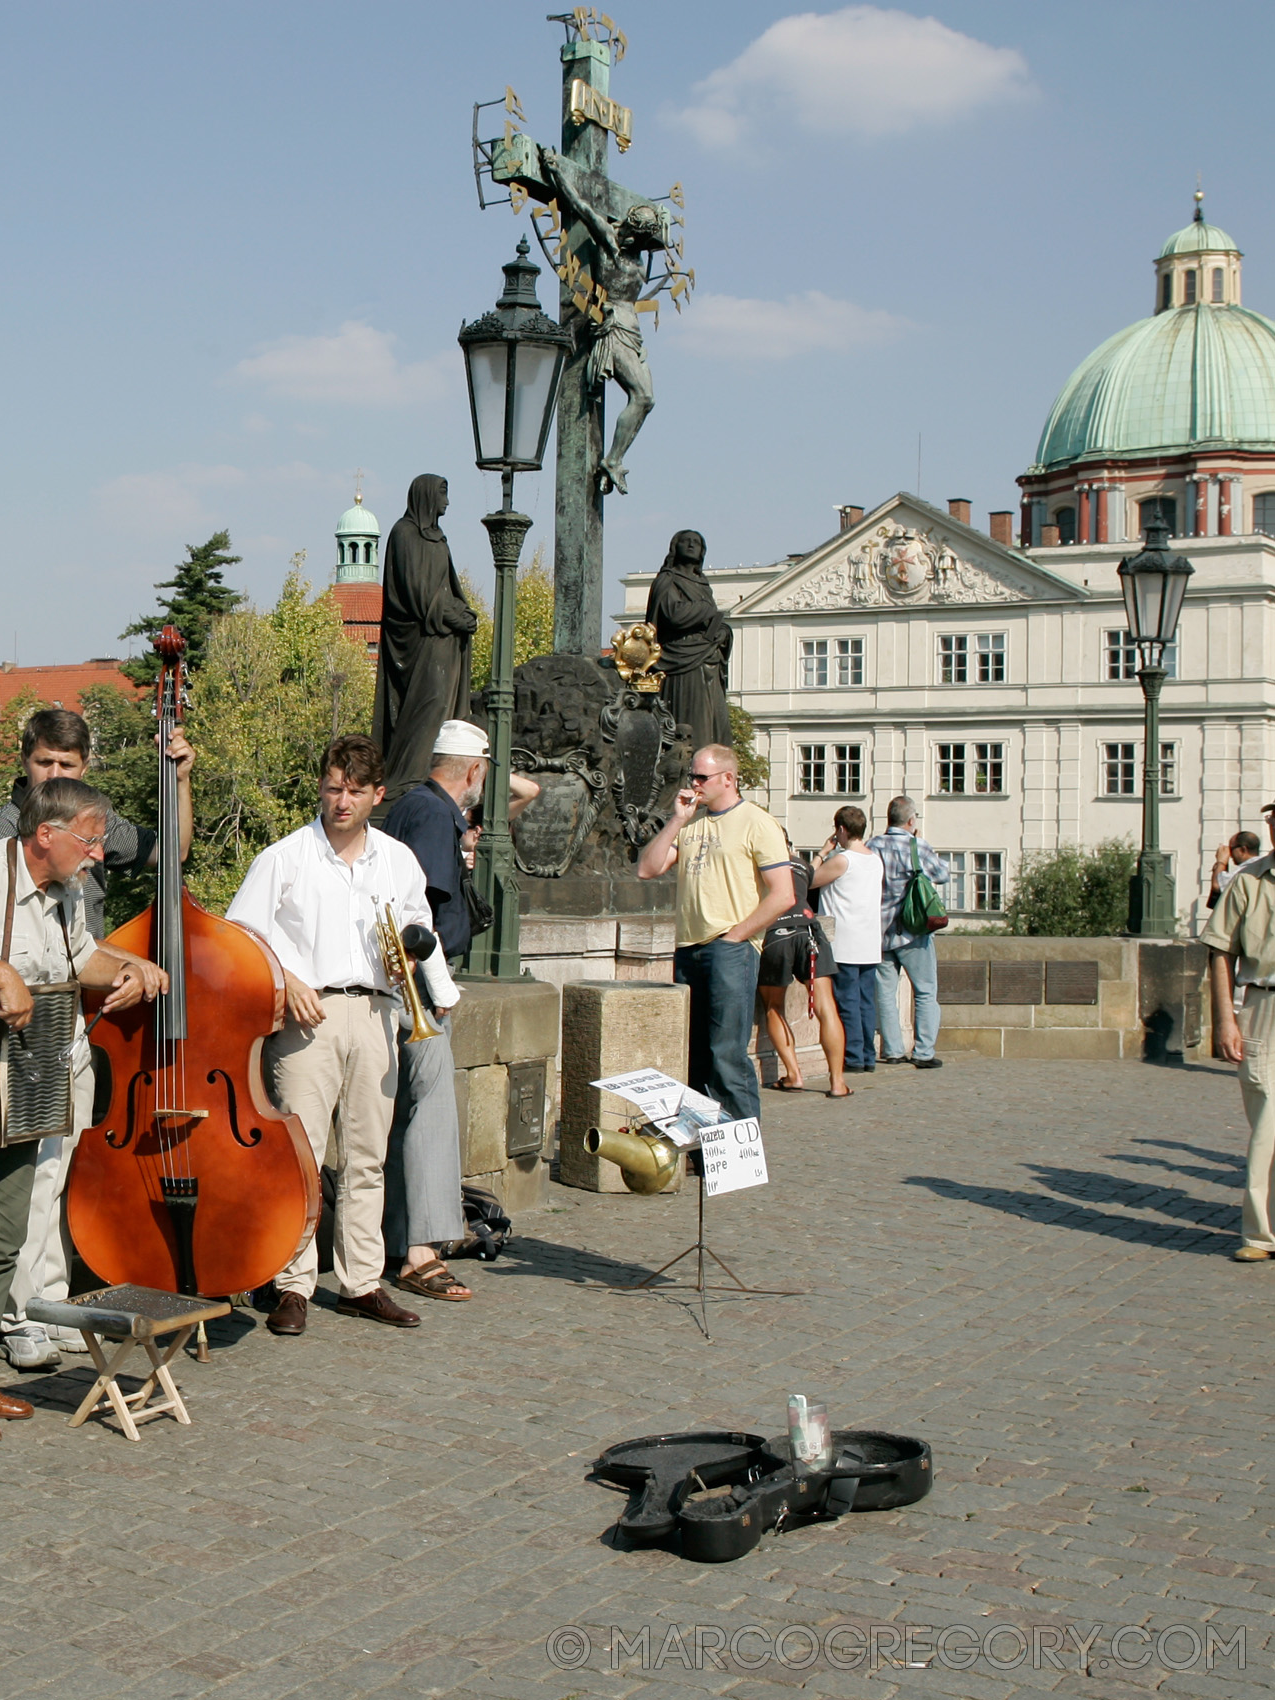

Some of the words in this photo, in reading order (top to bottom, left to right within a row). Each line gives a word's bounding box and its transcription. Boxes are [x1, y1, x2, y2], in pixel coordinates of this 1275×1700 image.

[630, 1081, 676, 1094] BAND
[700, 1129, 725, 1144] kazeta
[733, 1121, 759, 1145] CD
[706, 1160, 728, 1174] tape
